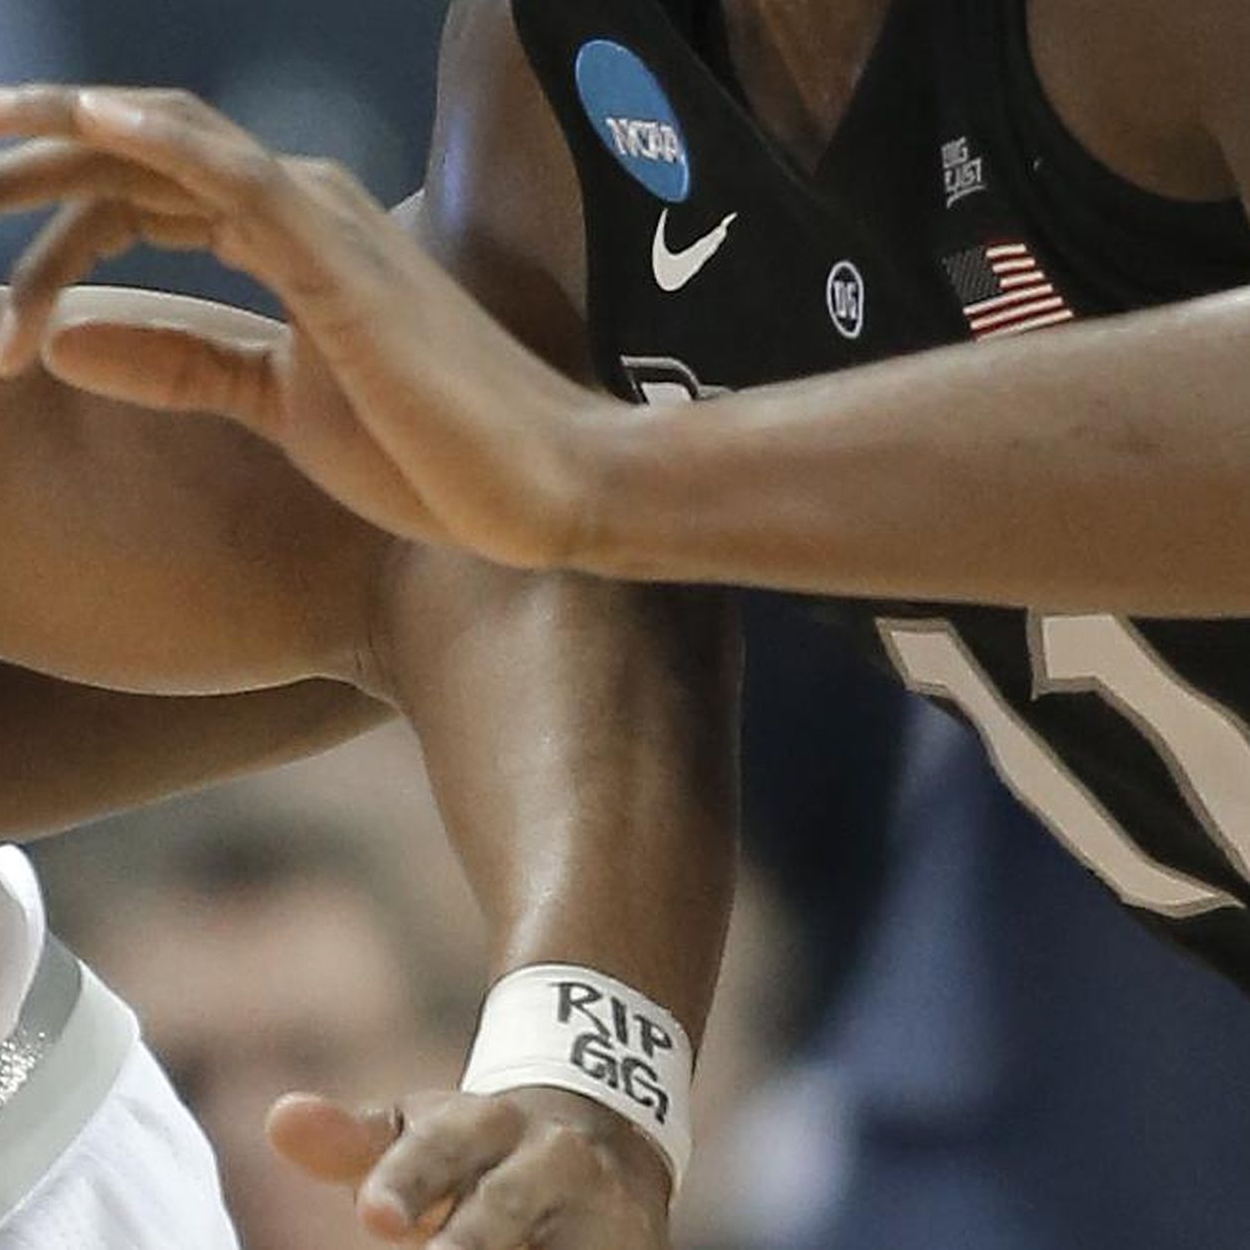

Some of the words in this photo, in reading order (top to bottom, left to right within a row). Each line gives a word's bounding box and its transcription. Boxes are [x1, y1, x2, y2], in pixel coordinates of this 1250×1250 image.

[605, 116, 680, 165] NCAA
[548, 982, 673, 1058] RIP
[570, 1033, 669, 1125] GG
